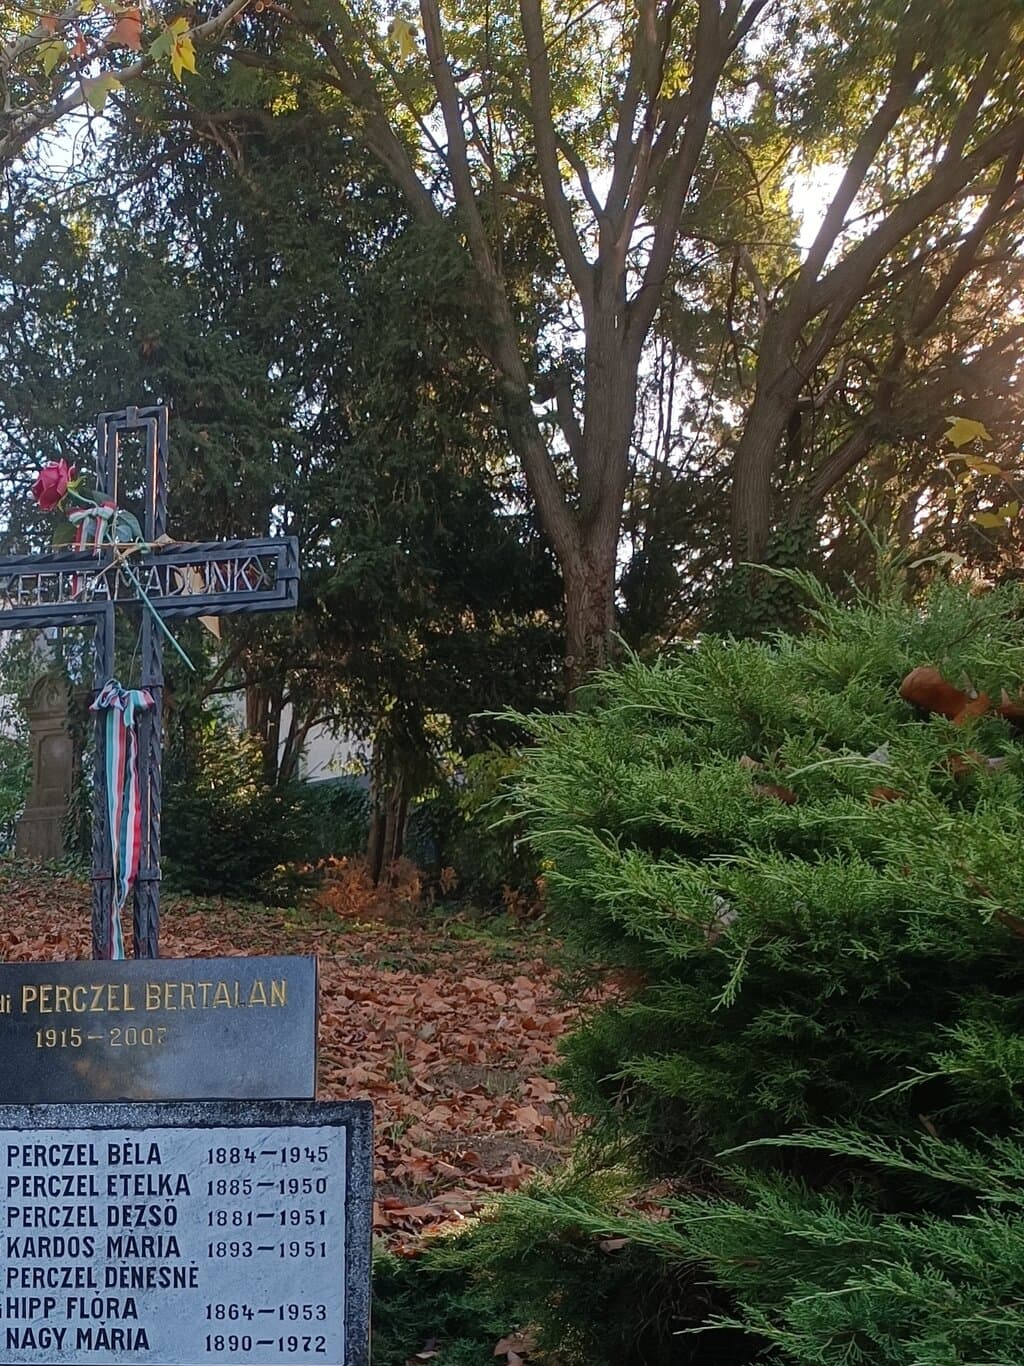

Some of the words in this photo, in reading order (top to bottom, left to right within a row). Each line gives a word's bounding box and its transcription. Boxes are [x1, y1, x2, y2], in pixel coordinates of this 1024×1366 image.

[21, 983, 135, 1013] PERCZEL
[146, 979, 287, 1011] BERTALAN
[7, 1144, 99, 1167] PERCZEL
[108, 1137, 162, 1165] BÉLA
[7, 1175, 99, 1198] PERCZEL
[107, 1173, 191, 1197] ETELKA
[7, 1205, 99, 1228] PERCZEL
[6, 1236, 95, 1259] KARDOS
[106, 1229, 181, 1258] MÁRIA
[6, 1266, 97, 1289] PERCZEL
[105, 1260, 199, 1289] DÉNESNÉ
[6, 1297, 56, 1319] HIPP
[66, 1290, 138, 1320] FLÓRA
[6, 1327, 67, 1350] NAGY
[76, 1321, 150, 1350] MÁRIA
